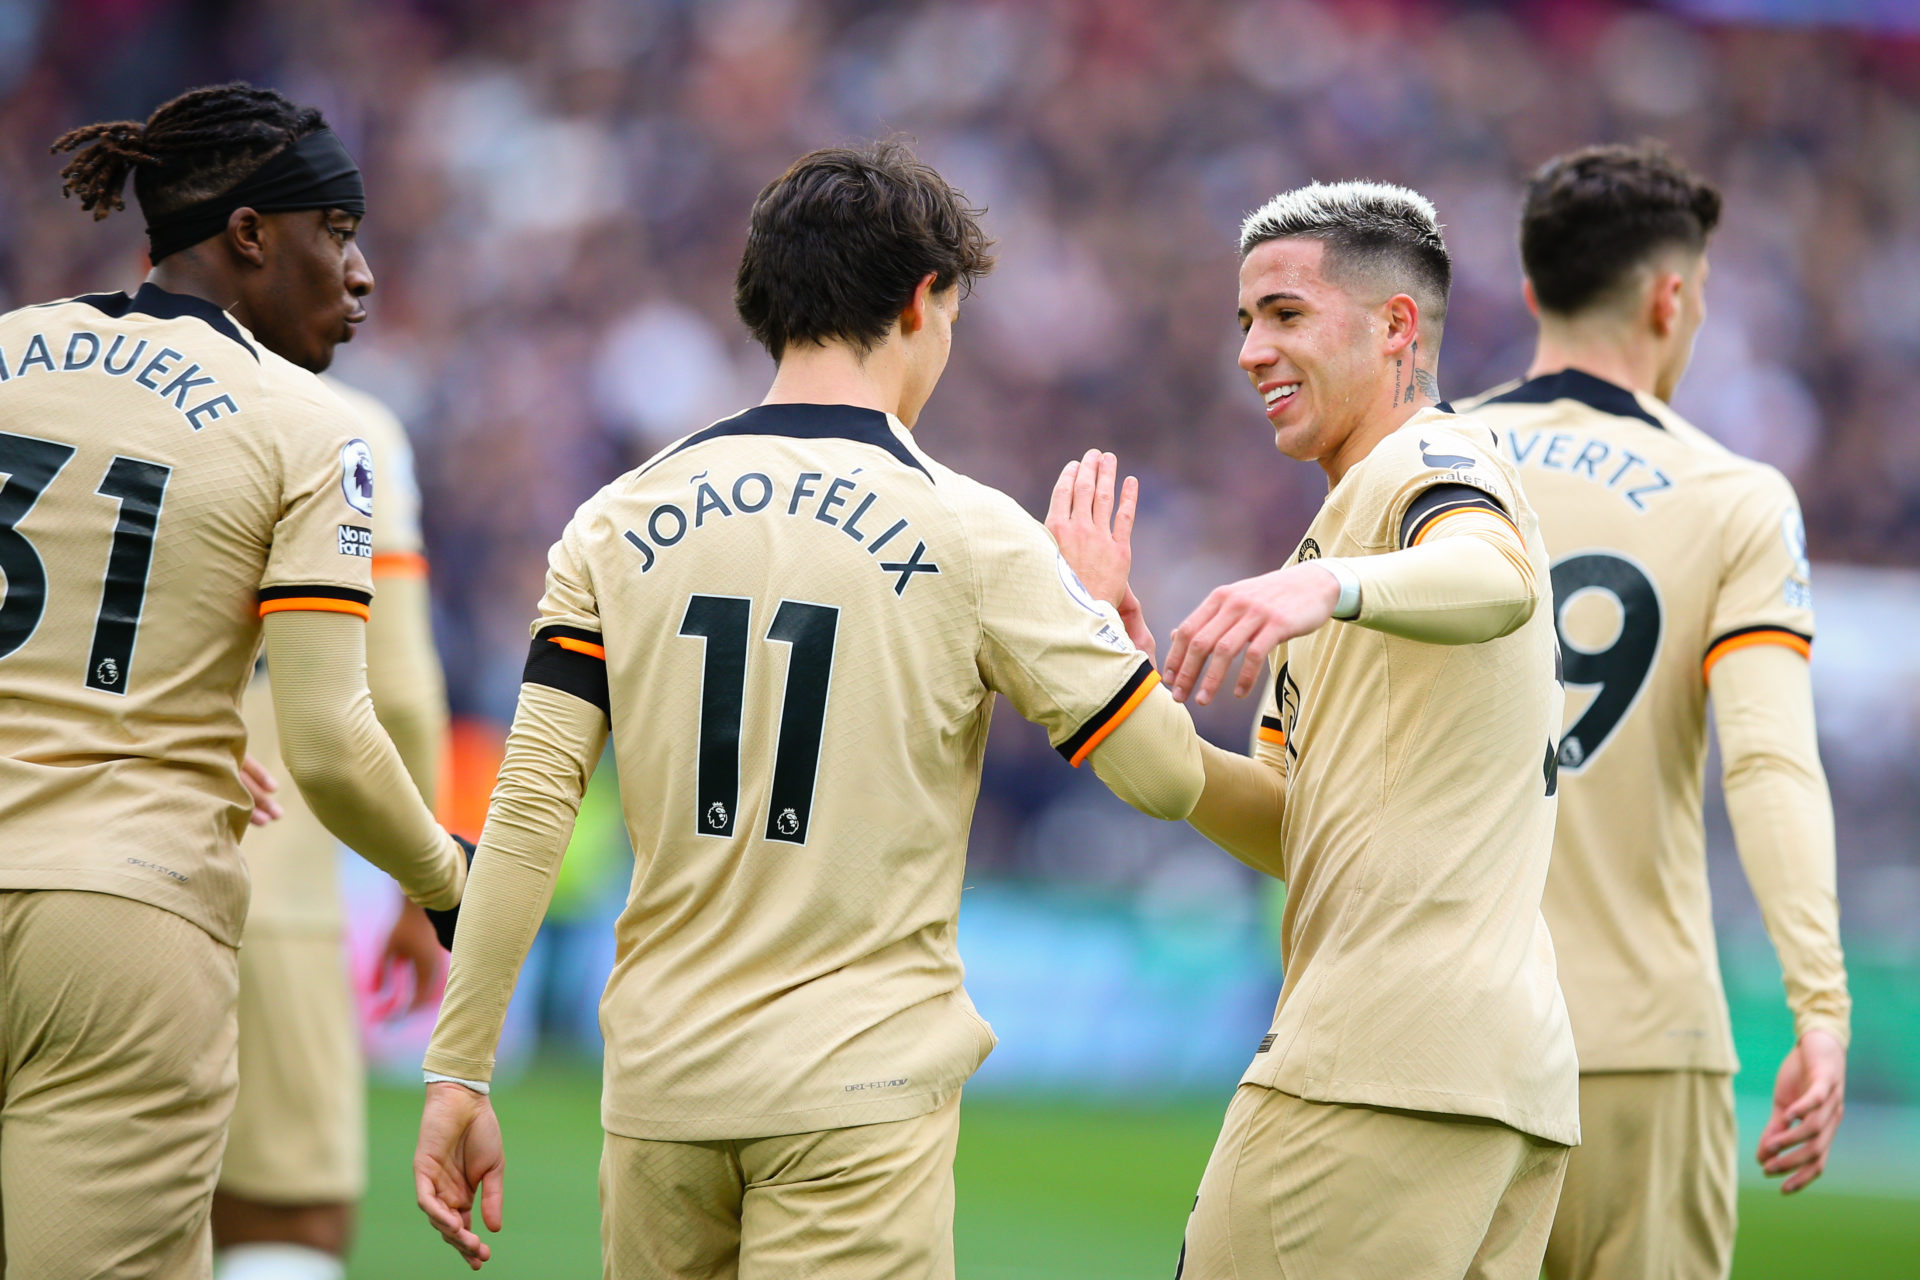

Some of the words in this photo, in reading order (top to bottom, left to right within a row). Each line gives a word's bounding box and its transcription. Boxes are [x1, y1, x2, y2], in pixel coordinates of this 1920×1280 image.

[0, 431, 174, 697] 31
[338, 525, 358, 542] No
[338, 539, 358, 555] for
[622, 469, 774, 574] JOÃO
[787, 467, 942, 598] FÉLIX
[676, 592, 842, 847] 11
[1549, 546, 1665, 776] 9
